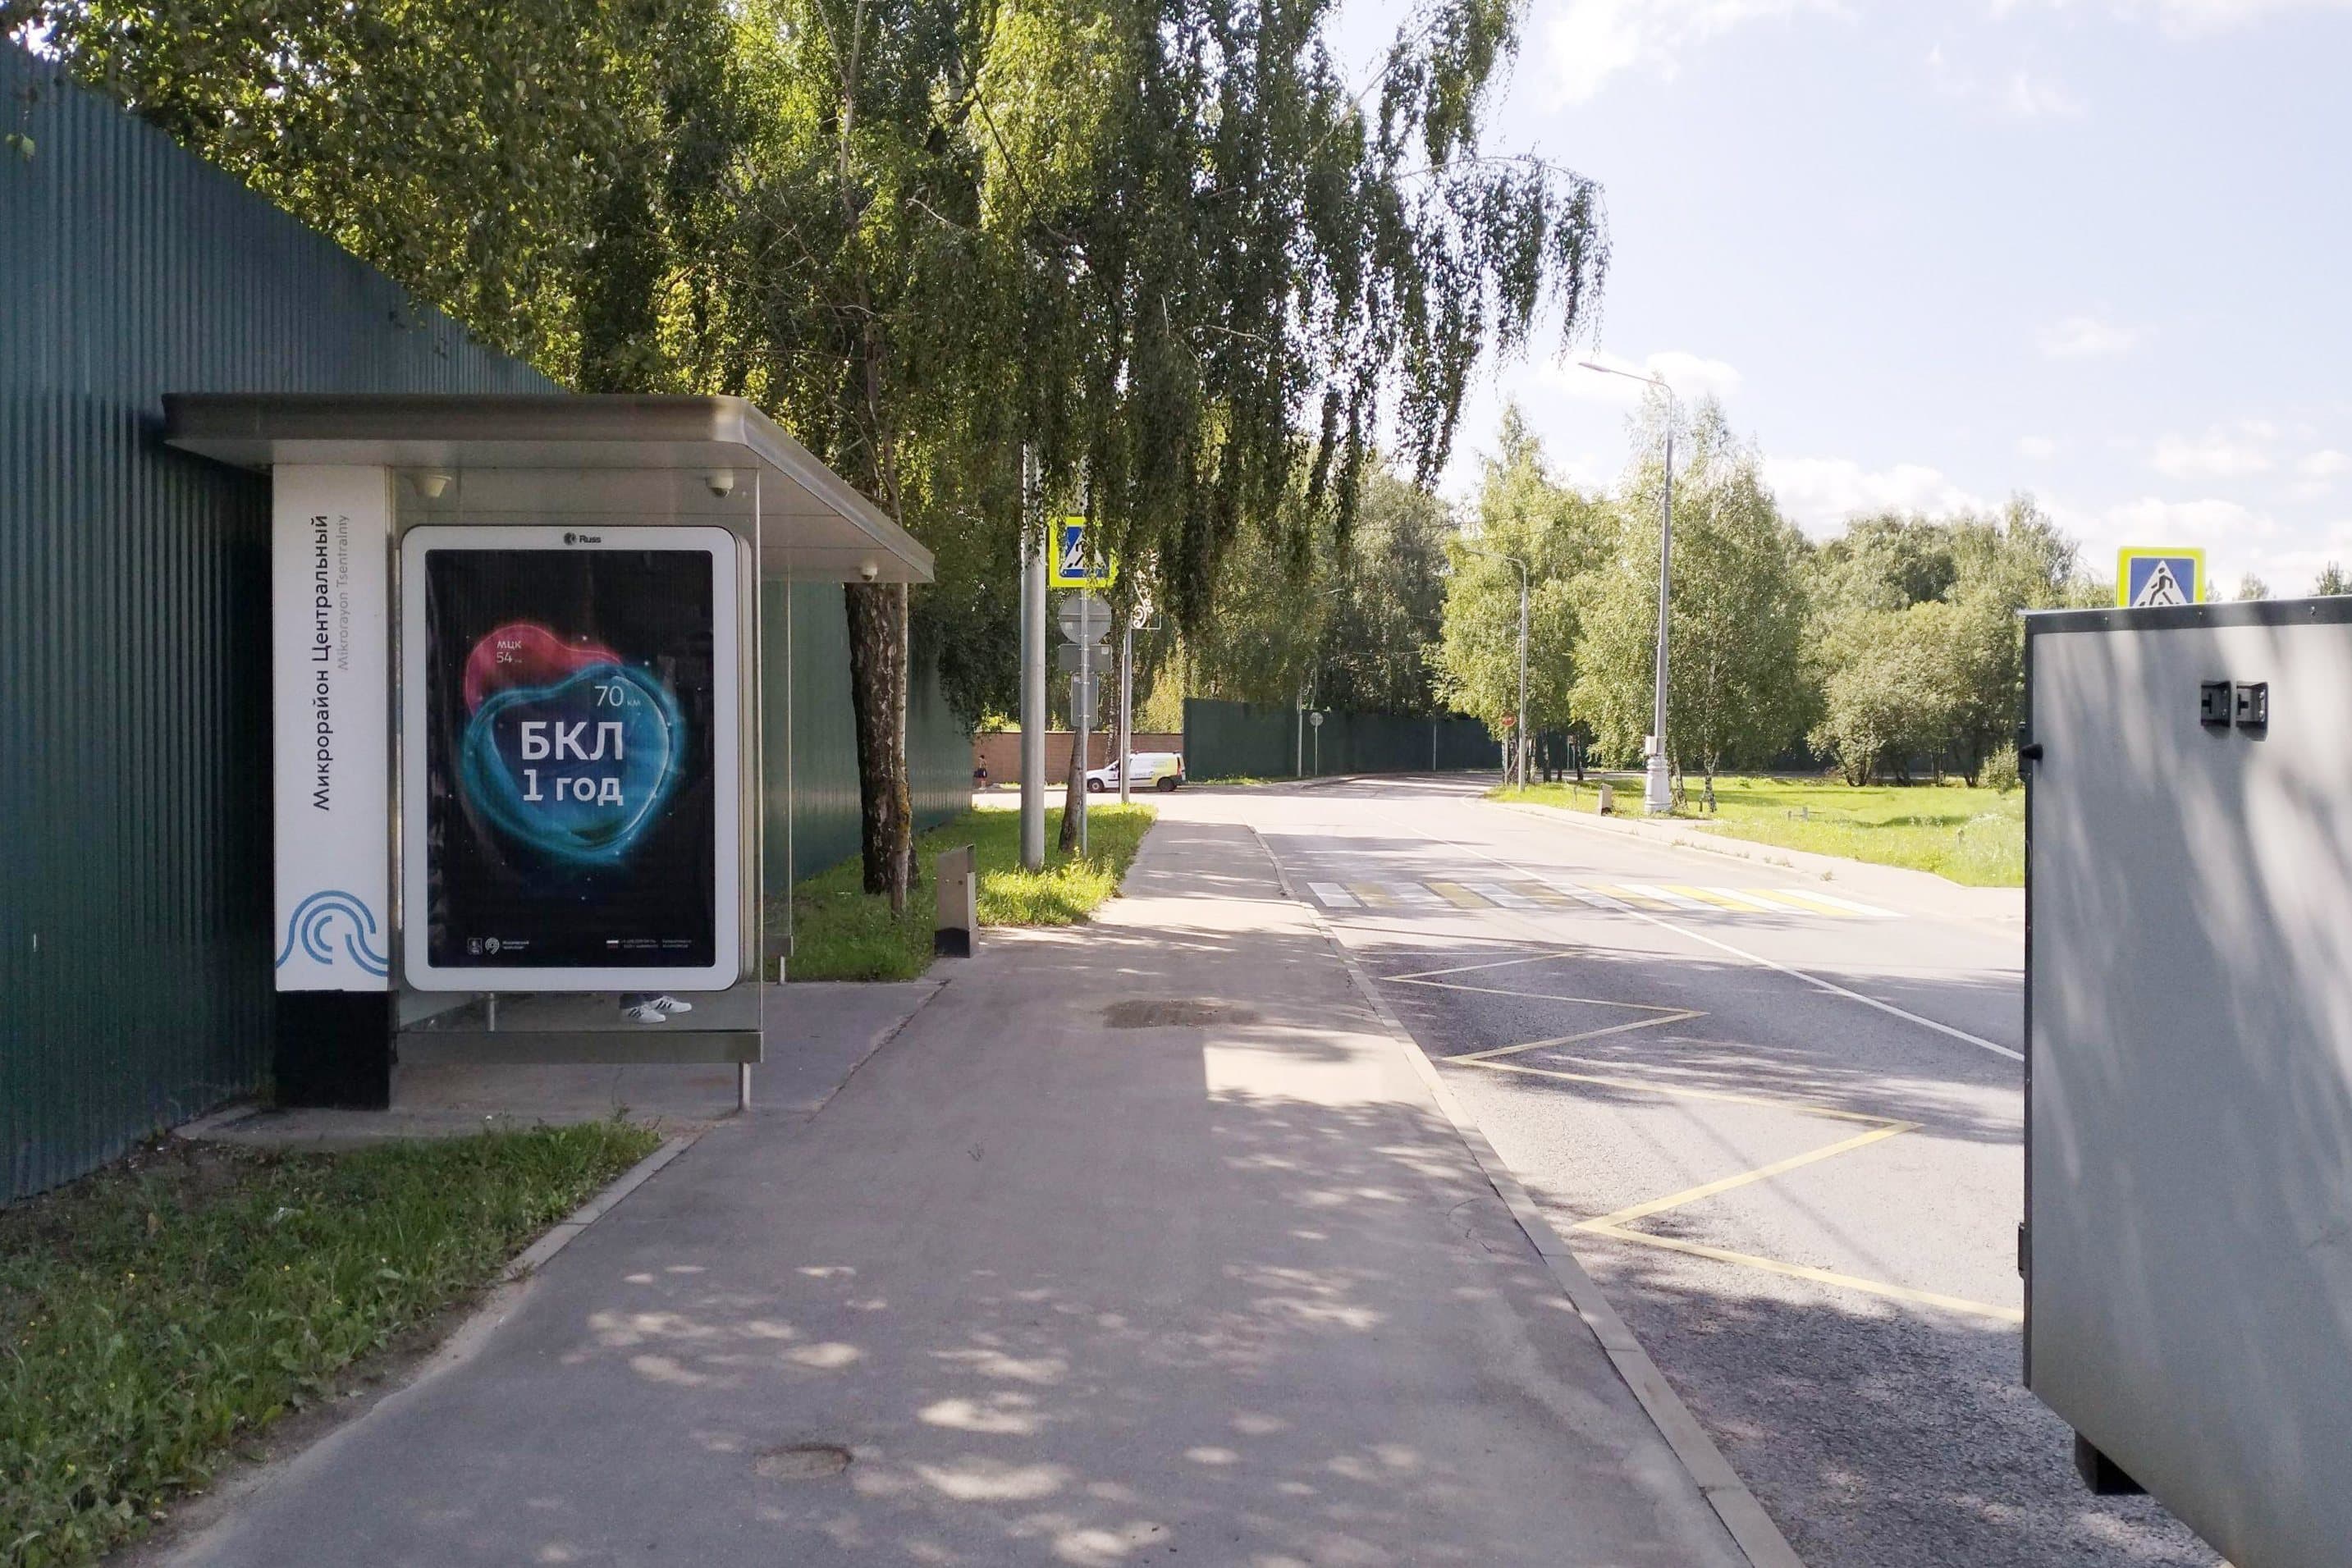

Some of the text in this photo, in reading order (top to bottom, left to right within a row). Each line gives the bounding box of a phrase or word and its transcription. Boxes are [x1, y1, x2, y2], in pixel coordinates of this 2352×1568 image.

[336, 514, 350, 671] Mikrorayon Tsentralniy
[311, 515, 333, 811] Микрорайон Центральный
[496, 651, 513, 663] 54
[594, 685, 624, 706] 70
[521, 721, 624, 761] БКЛ
[523, 769, 624, 807] 1 год
